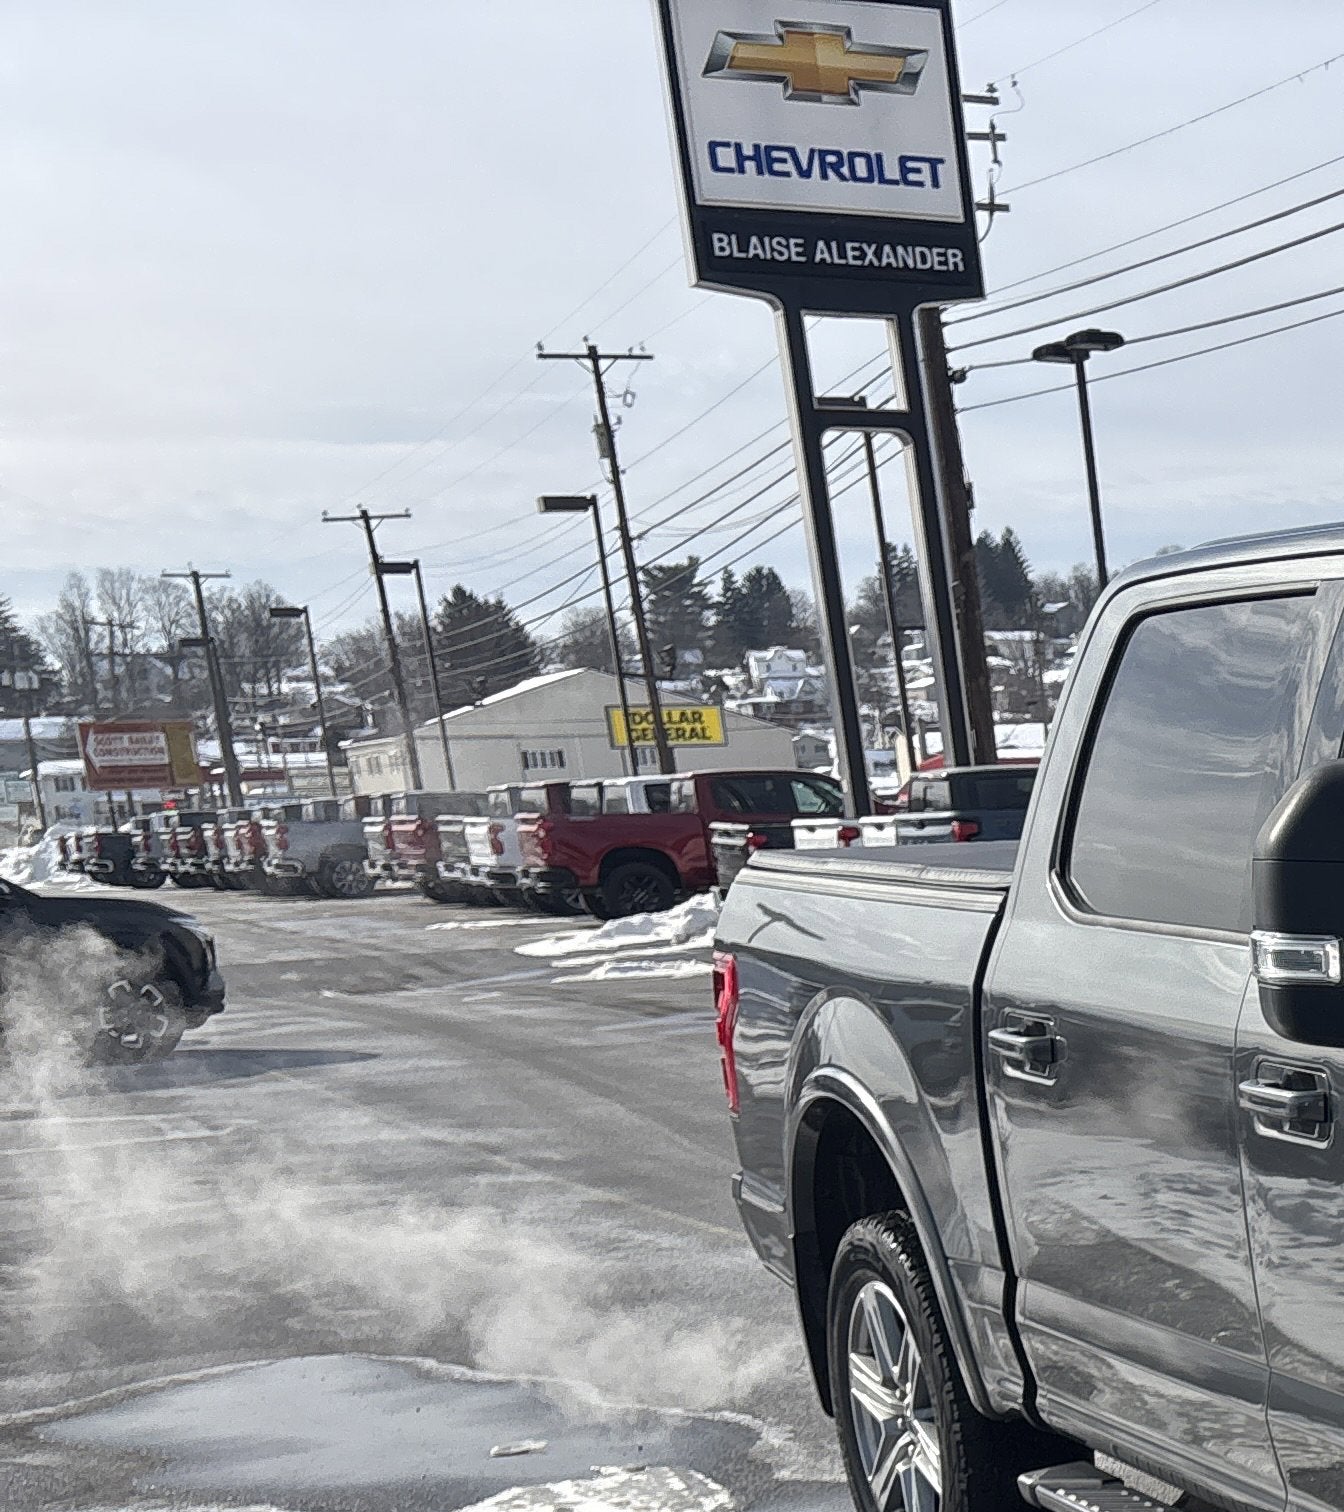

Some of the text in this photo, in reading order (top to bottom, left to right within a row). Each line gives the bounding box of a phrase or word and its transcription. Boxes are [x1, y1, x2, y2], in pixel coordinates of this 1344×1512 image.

[707, 140, 945, 189] CHEVROLET
[711, 233, 965, 272] BLAISE ALEXANDER
[630, 709, 705, 725] DOLAR
[630, 726, 713, 742] GEERAL
